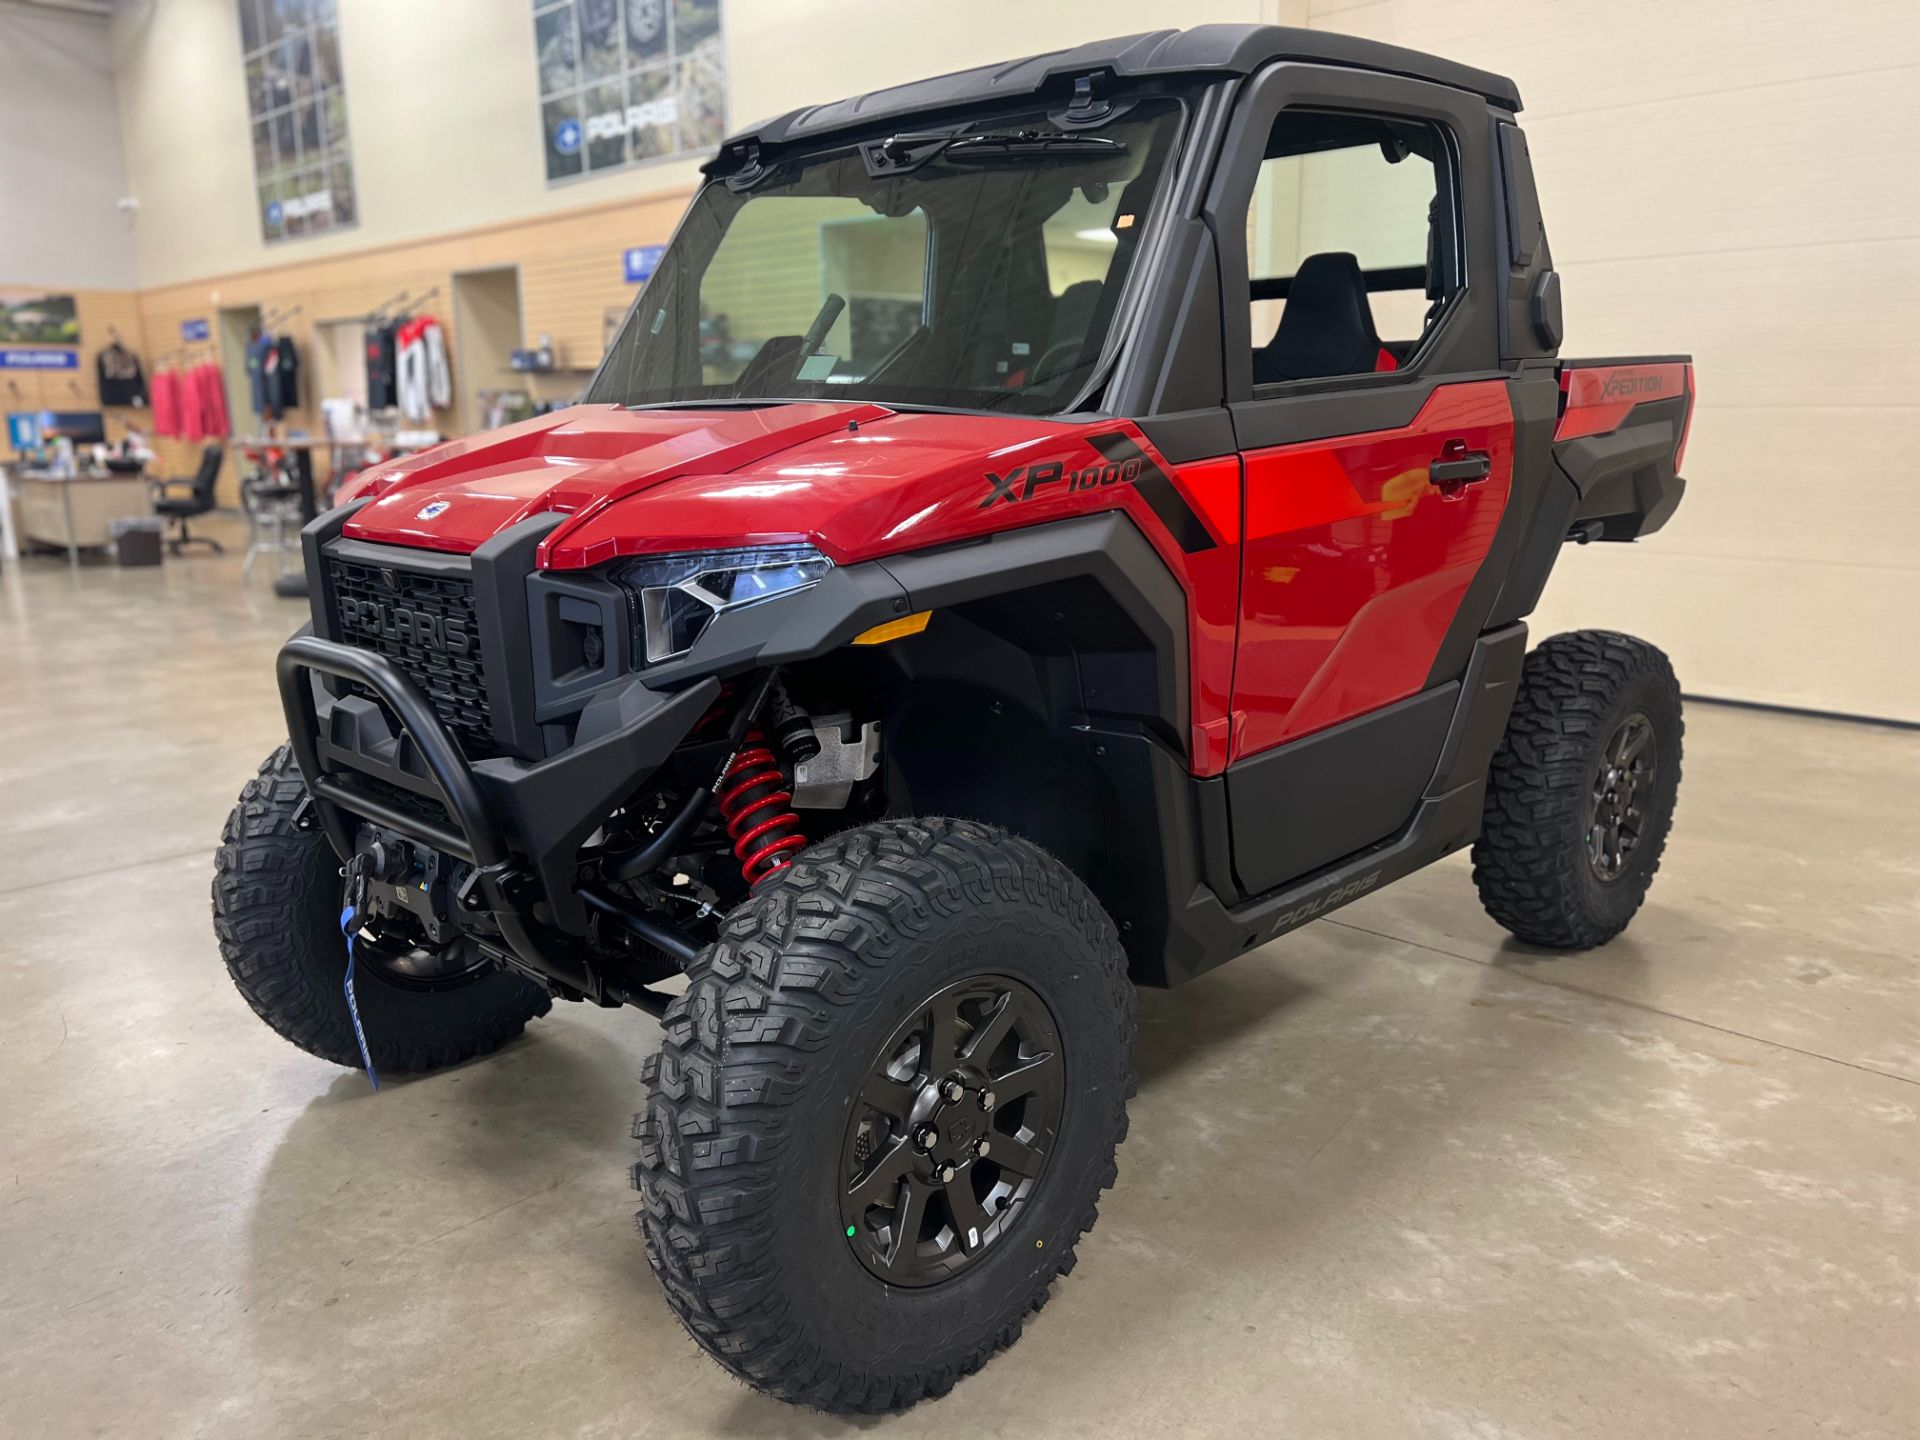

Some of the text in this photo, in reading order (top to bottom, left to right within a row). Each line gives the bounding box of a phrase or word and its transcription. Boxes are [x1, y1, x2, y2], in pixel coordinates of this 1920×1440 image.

[1599, 371, 1663, 401] XPEDITION
[976, 458, 1142, 510] XP 1000
[339, 596, 470, 654] POLARIS
[711, 751, 737, 793] POLARIS
[1270, 869, 1382, 934] POLARIS
[346, 978, 372, 1068] POLARIS
